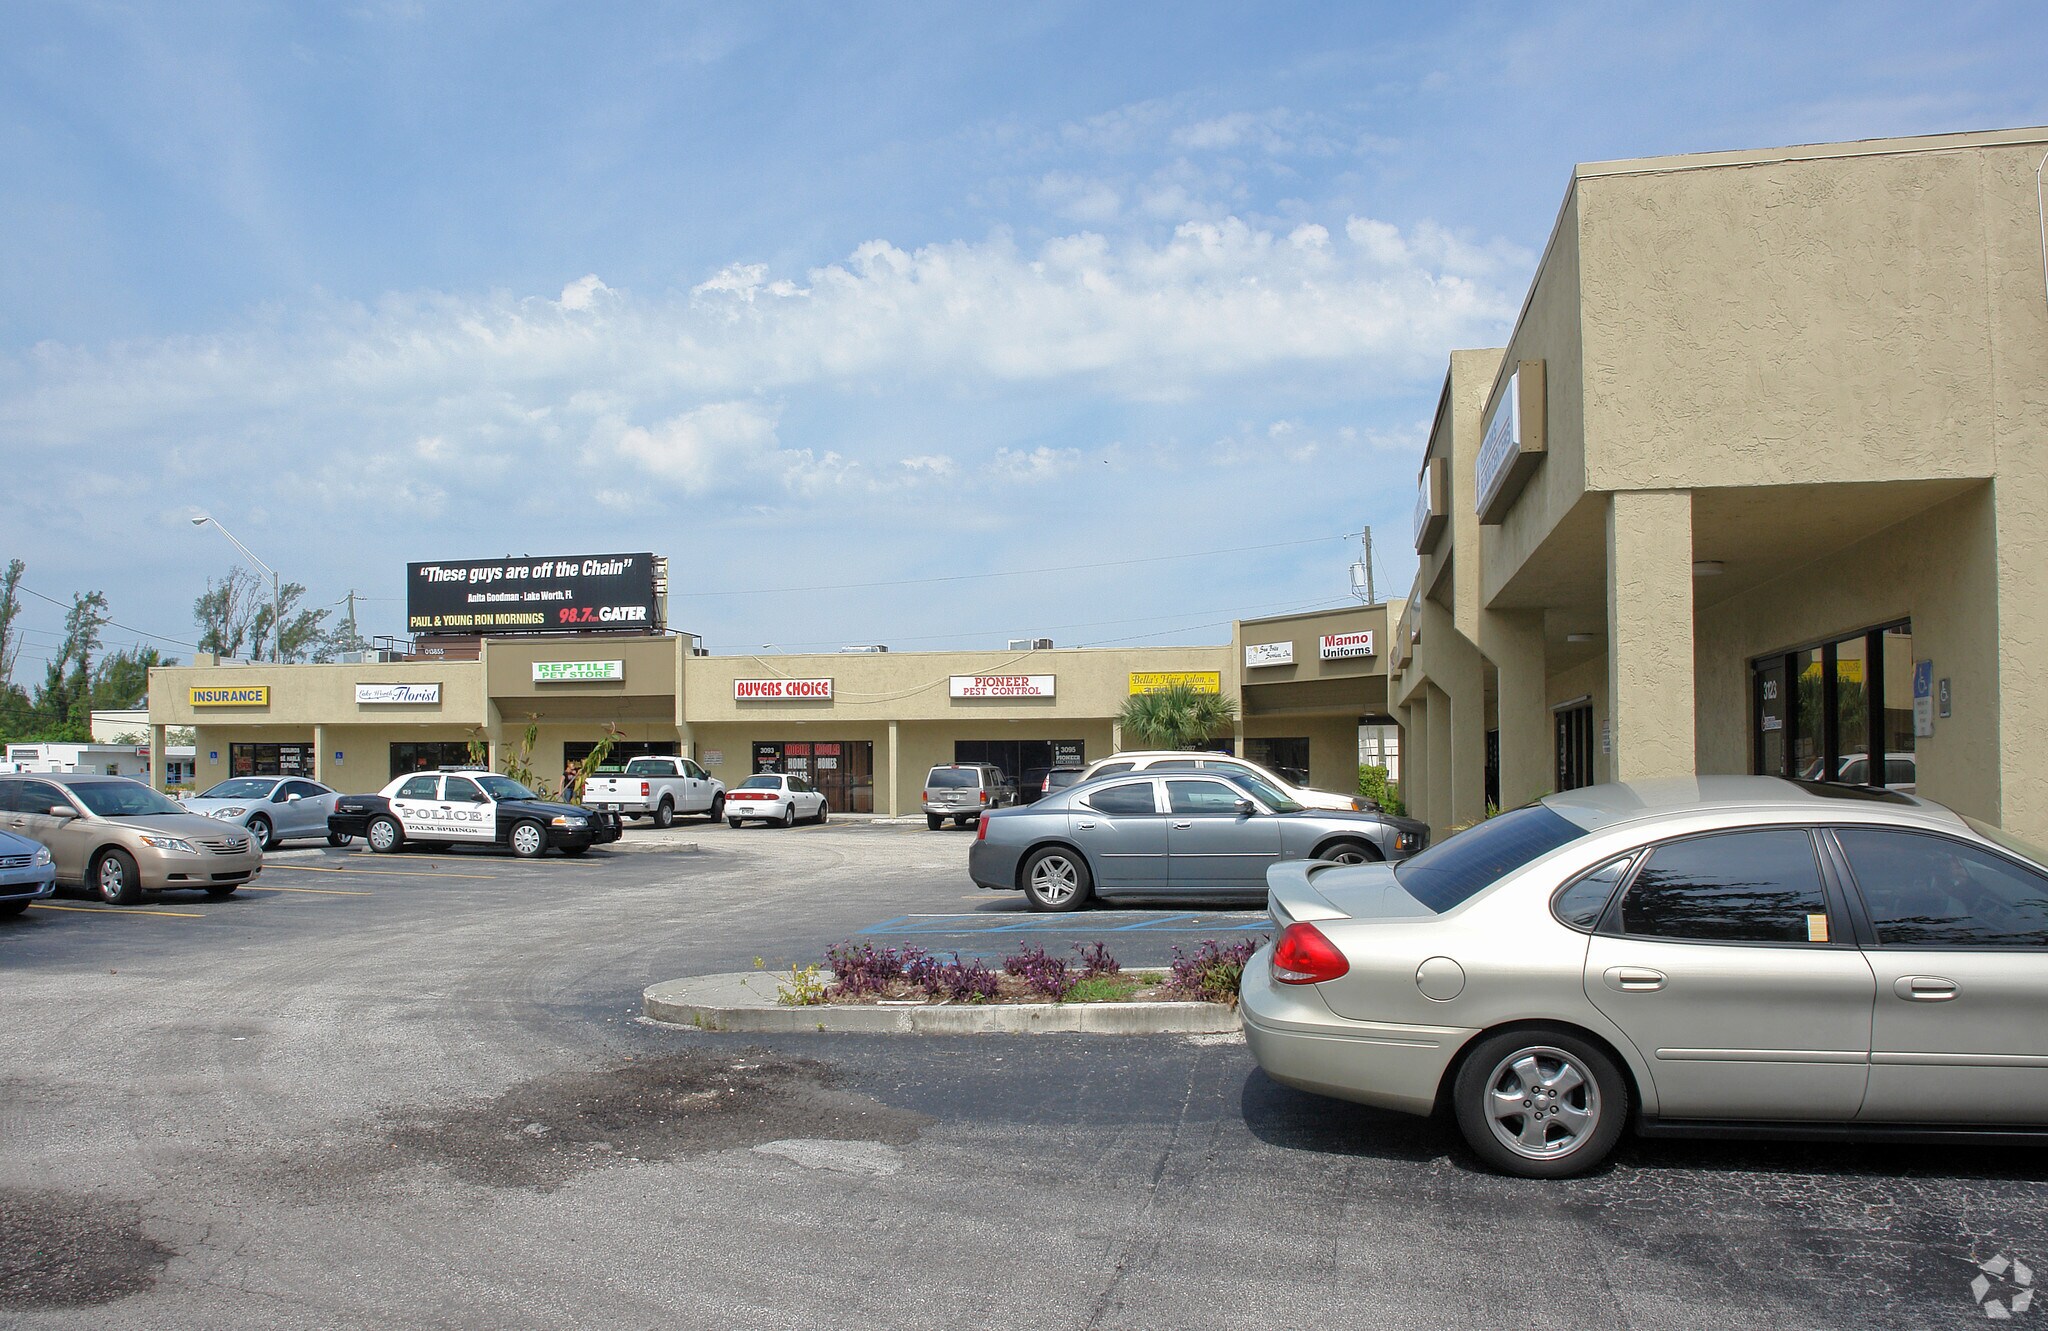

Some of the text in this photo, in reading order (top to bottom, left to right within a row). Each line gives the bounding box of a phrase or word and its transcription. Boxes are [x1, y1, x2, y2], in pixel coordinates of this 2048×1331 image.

[469, 567, 503, 584] guys
[505, 565, 530, 580] are
[532, 561, 554, 579] off
[555, 561, 579, 577] the
[467, 593, 486, 603] Anita
[487, 592, 520, 602] Goodman
[523, 591, 540, 601] Lake
[541, 590, 564, 601] Worth,
[410, 612, 545, 627] PAUL & YOUNG RON MORNINGS
[598, 606, 647, 622] GATER
[1324, 634, 1368, 647] Manno
[1323, 646, 1371, 658] Uniforms
[538, 662, 615, 672] REPTILE
[542, 670, 611, 679] PET STORE
[1132, 674, 1159, 686] Bella's
[974, 676, 1029, 687] PIONEER
[392, 686, 437, 701] Florist
[737, 682, 782, 696] BUYERS
[963, 686, 1041, 696] PEST CONTROL
[1763, 680, 1777, 700] 3123
[194, 690, 263, 702] INSURANCE
[784, 743, 810, 756] MOBILE
[787, 757, 837, 769] HOME HOMES
[402, 808, 482, 822] POLICE
